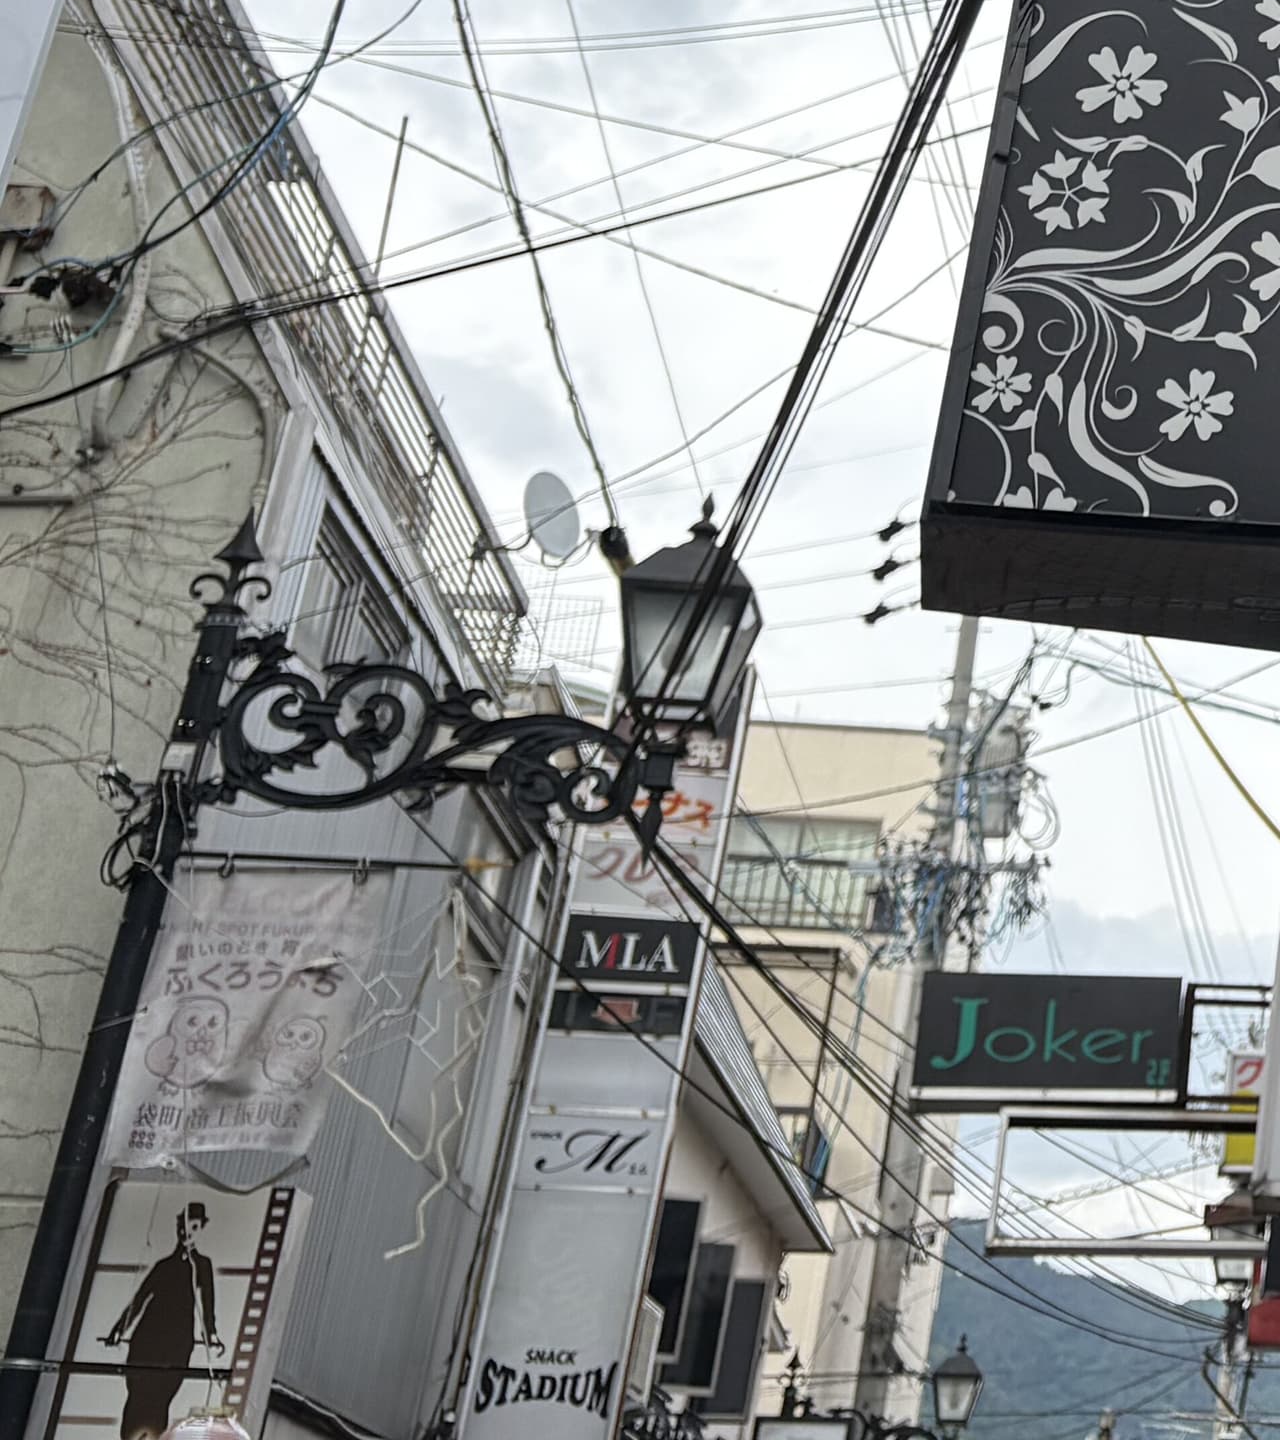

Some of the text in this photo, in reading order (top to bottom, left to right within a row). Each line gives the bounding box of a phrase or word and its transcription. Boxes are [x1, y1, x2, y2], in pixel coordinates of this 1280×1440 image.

[930, 997, 1154, 1069] Joker
[525, 1347, 577, 1365] SNACK
[474, 1358, 619, 1420] STADIUM
